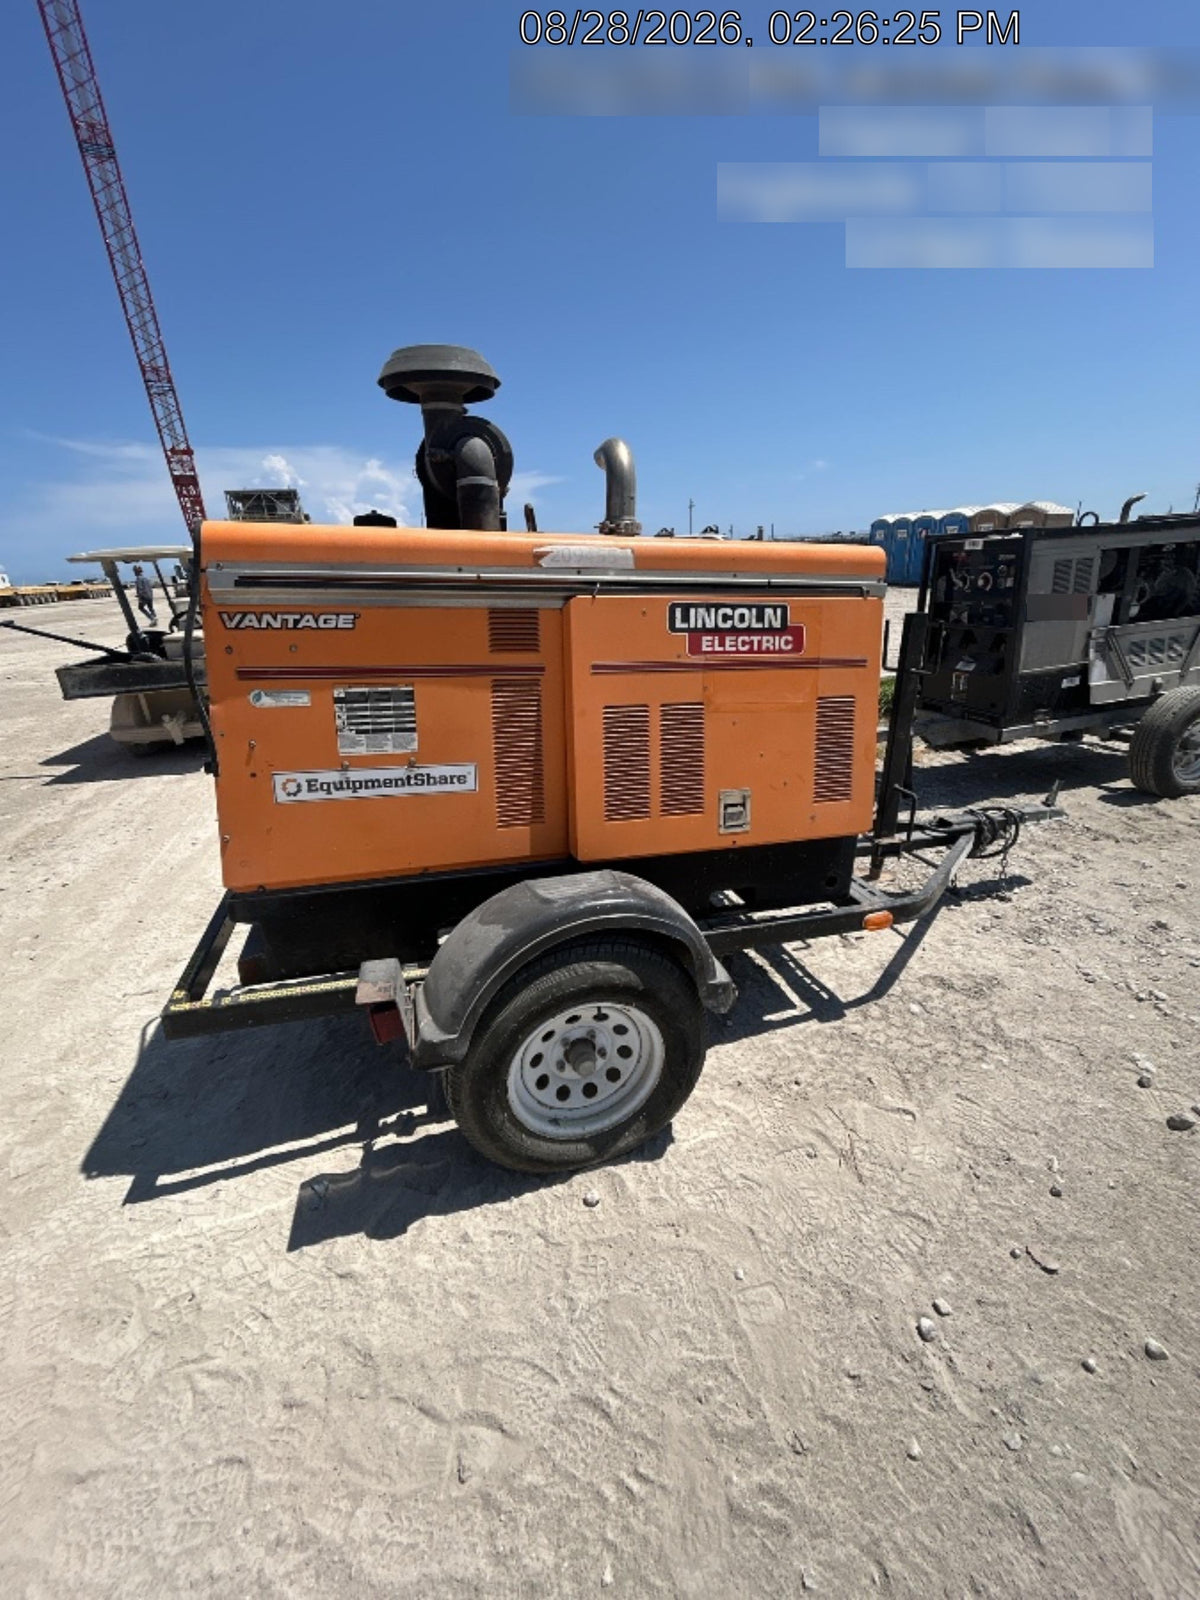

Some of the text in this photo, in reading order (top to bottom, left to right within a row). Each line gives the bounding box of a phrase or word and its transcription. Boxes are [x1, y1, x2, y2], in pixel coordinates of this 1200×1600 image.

[219, 612, 356, 629] VANTAGE
[674, 607, 782, 629] LINCOLN
[701, 635, 793, 652] ELECTRIC
[305, 772, 468, 793] EquipmentShare
